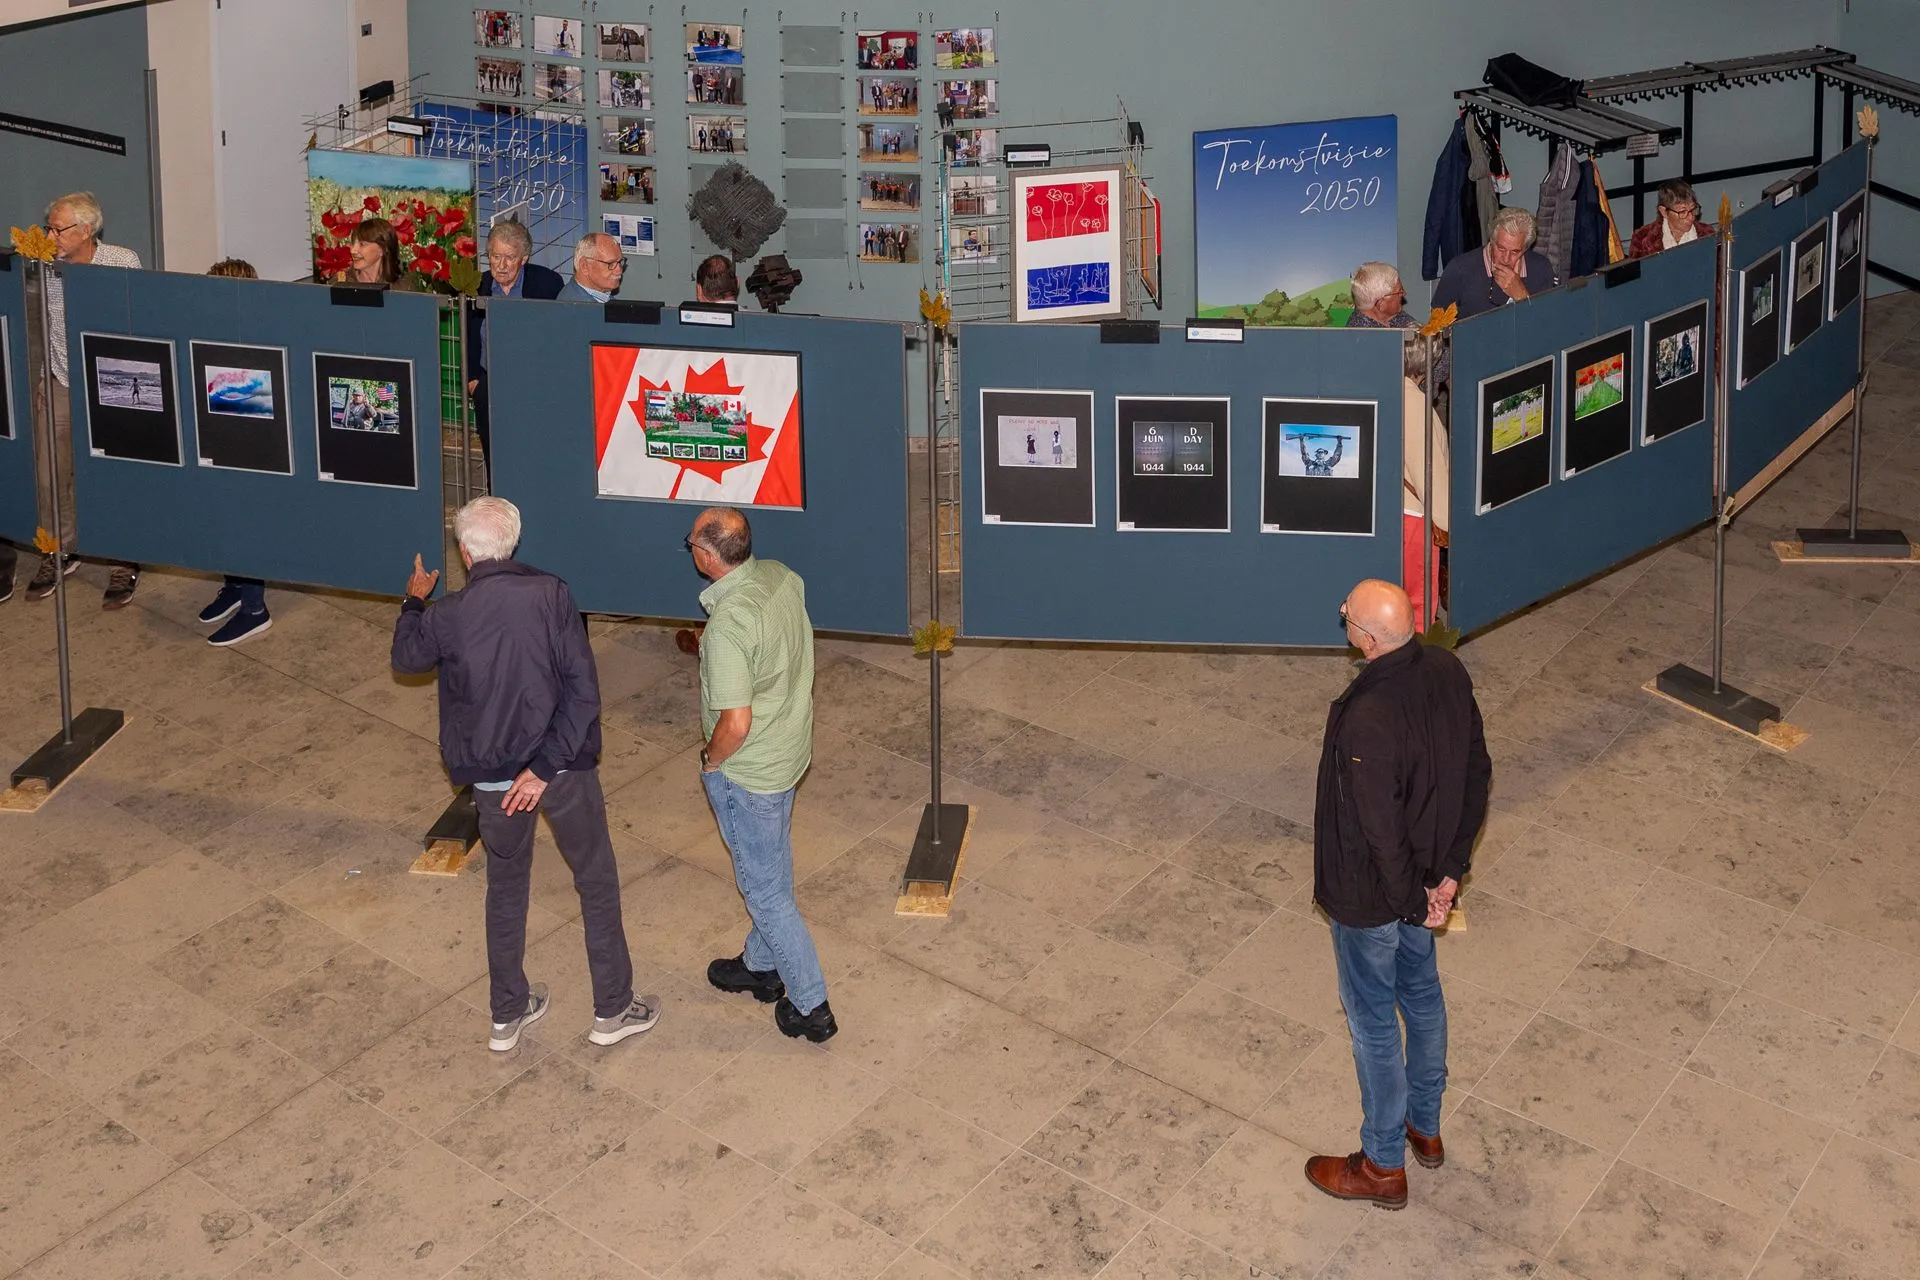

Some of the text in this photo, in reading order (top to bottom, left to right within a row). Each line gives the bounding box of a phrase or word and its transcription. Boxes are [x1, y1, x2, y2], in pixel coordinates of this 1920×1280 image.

[1203, 132, 1391, 190] Toekomstvisie
[493, 175, 565, 212] 2050
[1300, 176, 1380, 214] 2050
[1148, 426, 1156, 435] 6
[1190, 427, 1197, 435] D
[1142, 435, 1164, 443] JUIN
[1183, 435, 1203, 443] DAY
[1142, 463, 1164, 472] 1944
[1183, 463, 1205, 472] 1944
